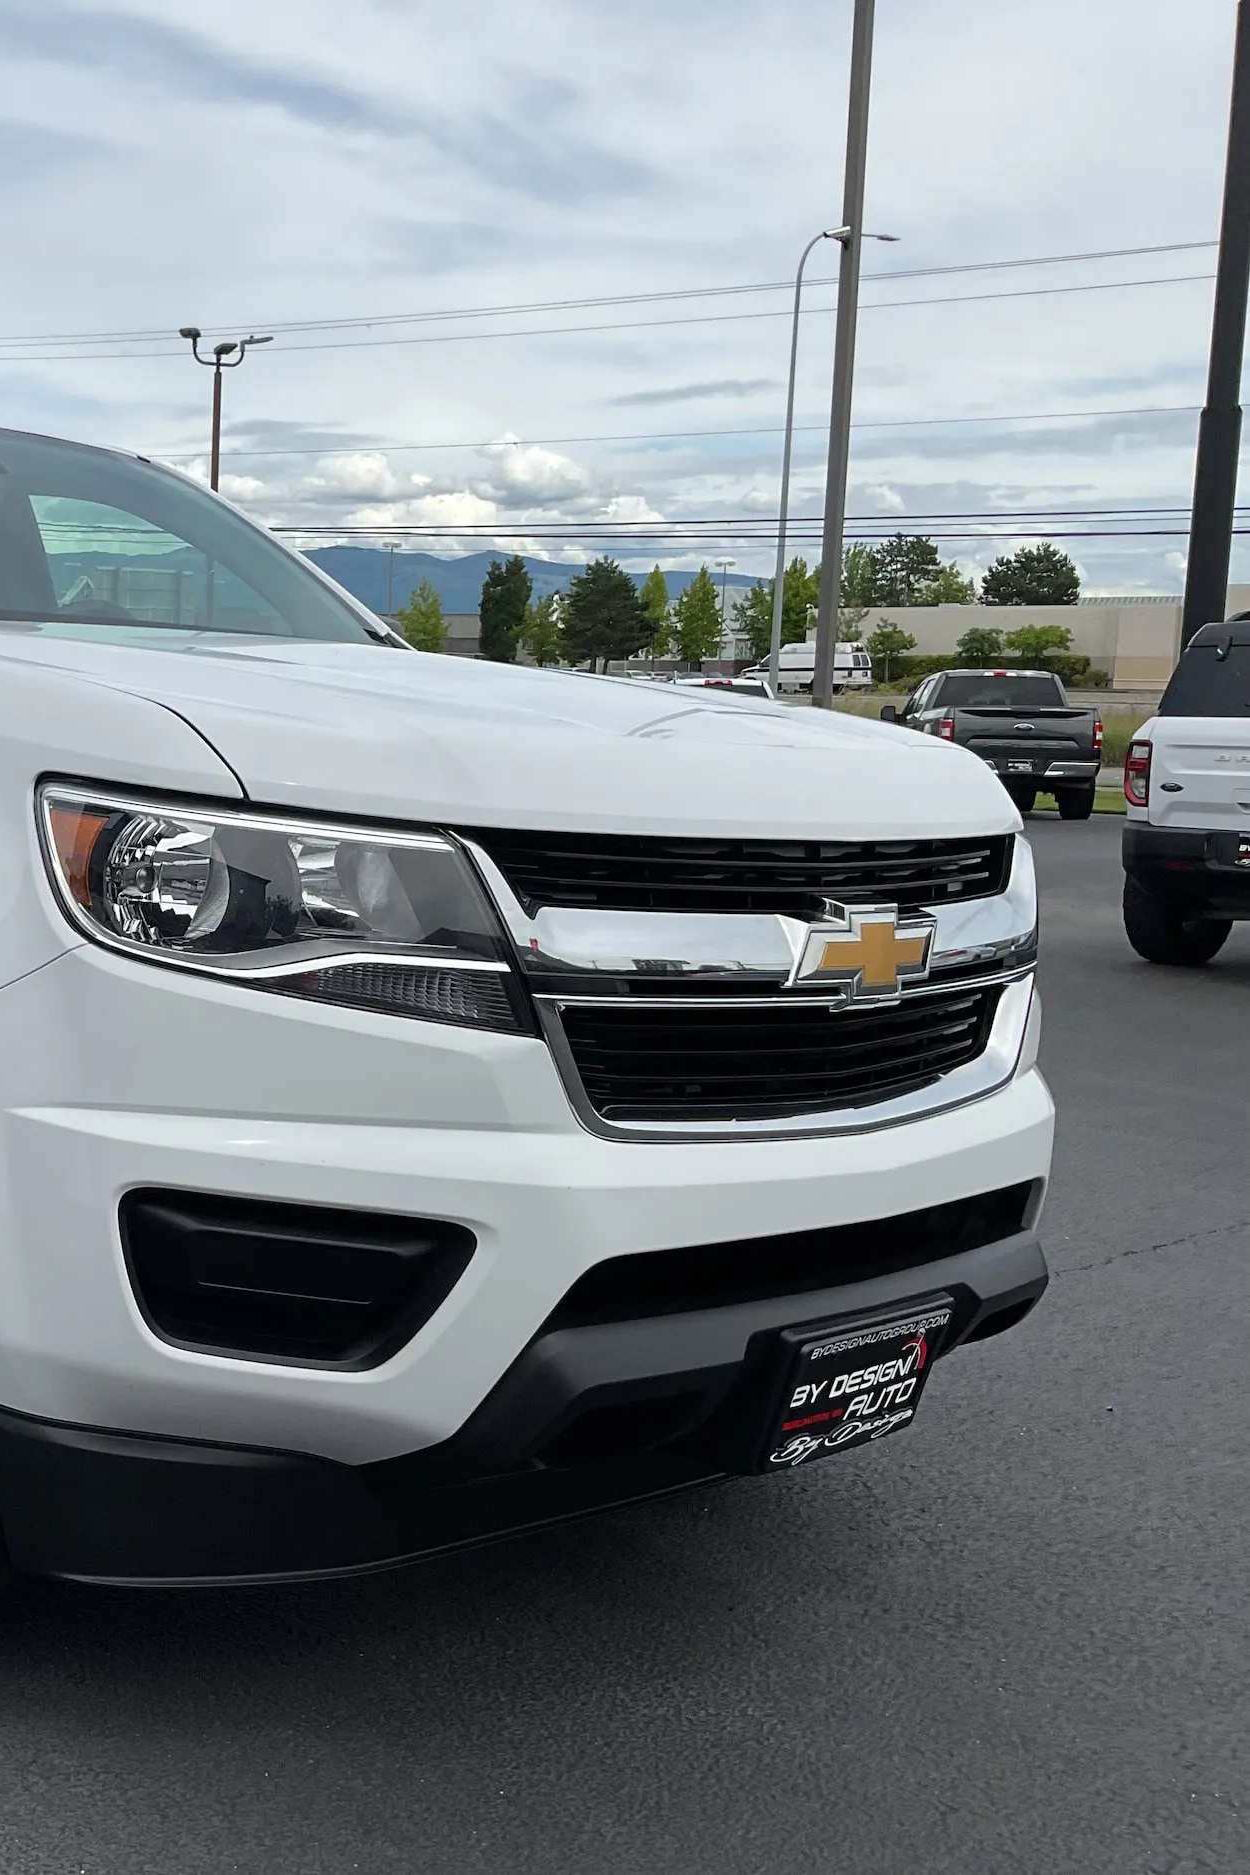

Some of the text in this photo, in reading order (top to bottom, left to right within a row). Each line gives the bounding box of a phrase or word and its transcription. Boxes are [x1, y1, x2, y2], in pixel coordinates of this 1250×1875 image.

[789, 1356, 912, 1408] BY DESIGN
[842, 1377, 917, 1421] AUTO
